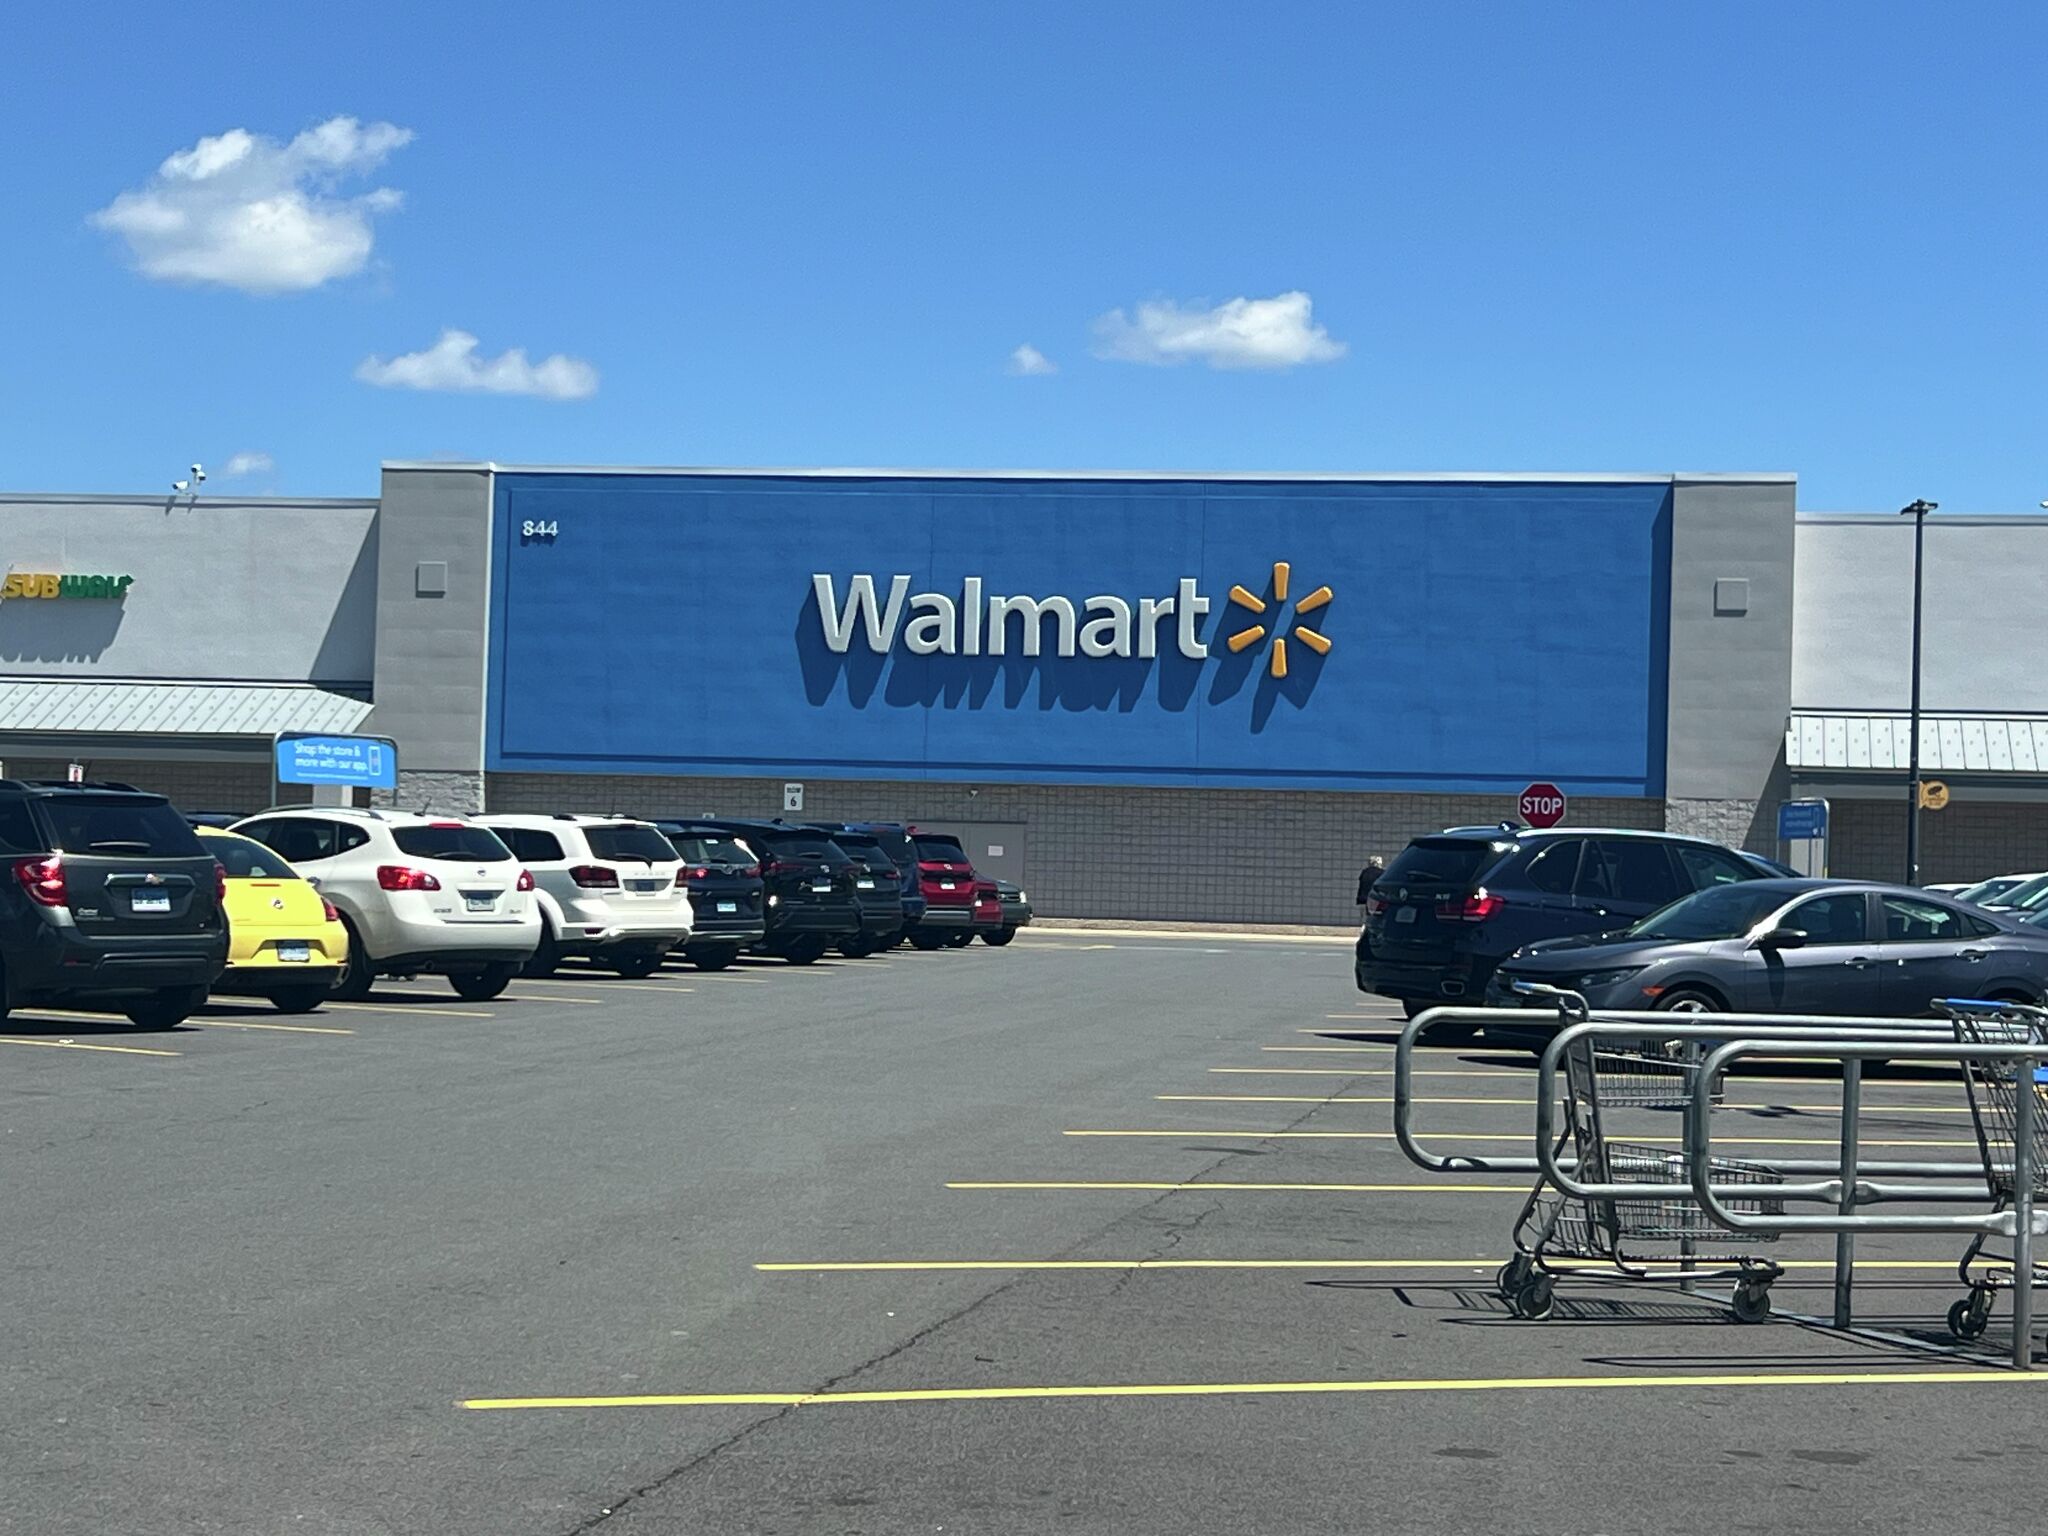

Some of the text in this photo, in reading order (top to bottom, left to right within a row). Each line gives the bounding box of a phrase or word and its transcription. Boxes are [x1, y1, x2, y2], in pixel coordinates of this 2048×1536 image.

[522, 520, 559, 537] 844
[0, 573, 134, 599] SUBWAY
[812, 573, 1210, 659] Walmart
[790, 796, 797, 806] 6
[1522, 797, 1562, 815] STOP
